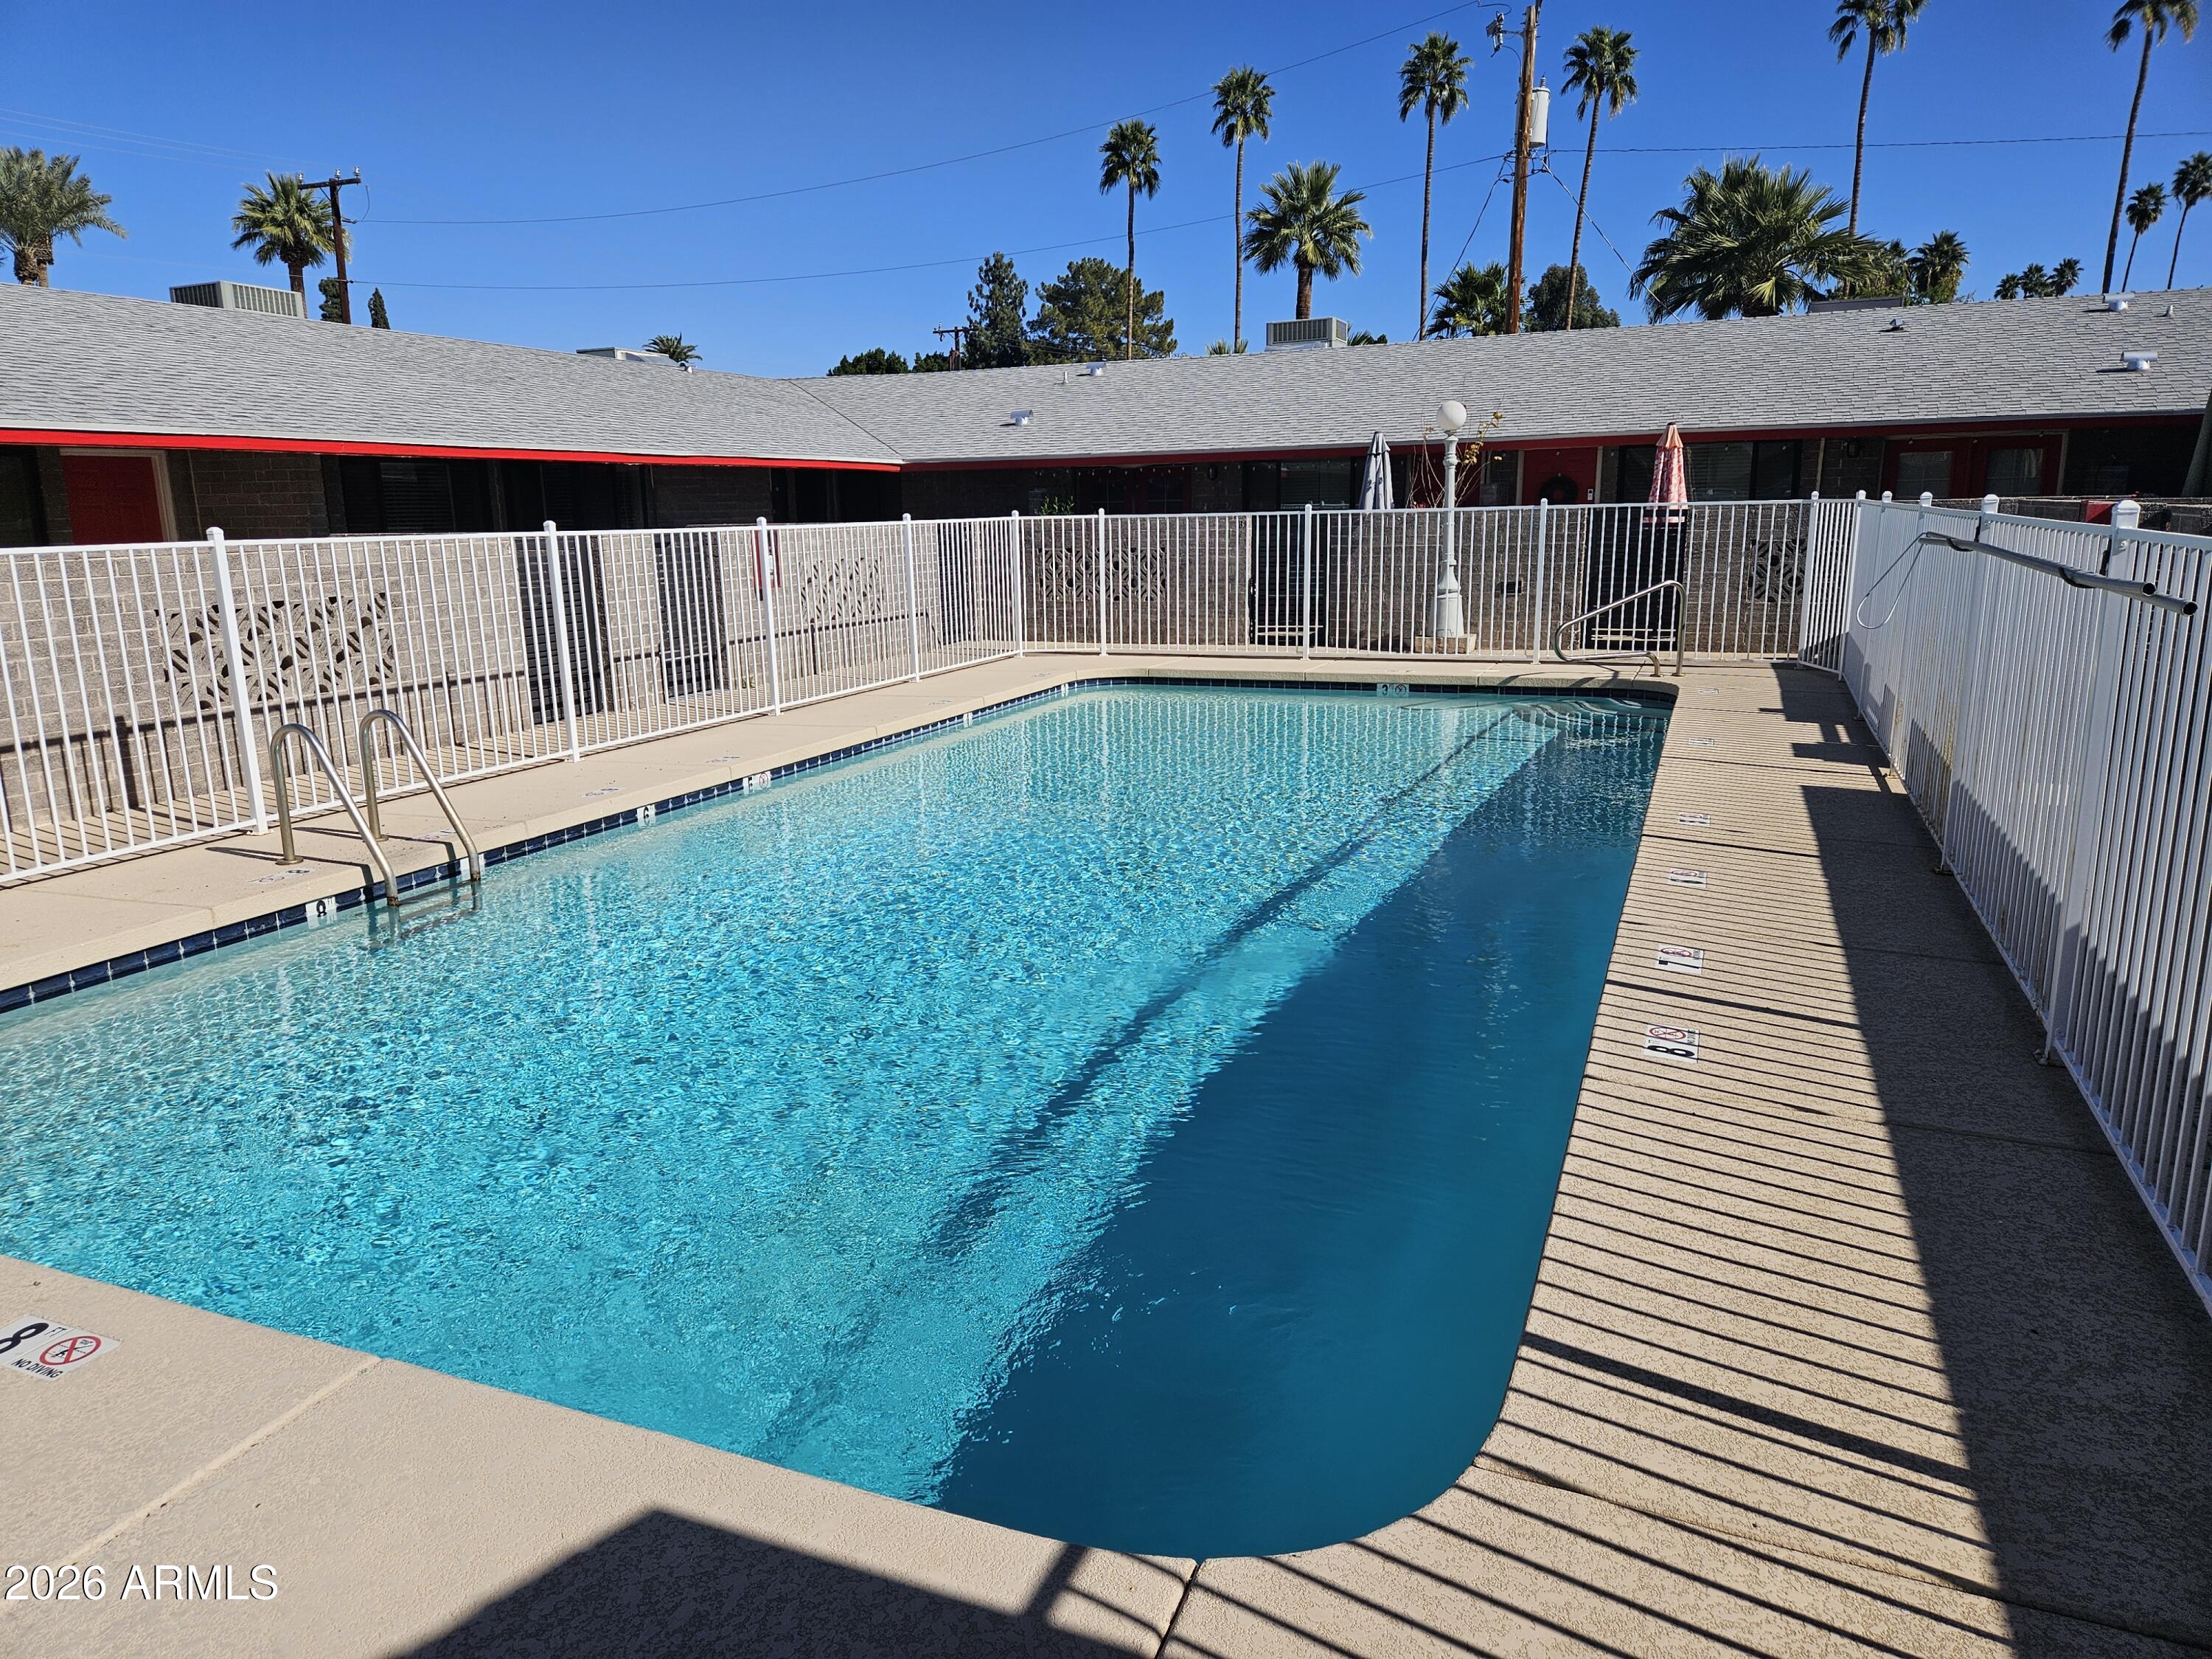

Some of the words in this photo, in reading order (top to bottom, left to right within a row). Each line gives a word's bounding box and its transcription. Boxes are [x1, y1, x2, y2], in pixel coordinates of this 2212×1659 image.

[1382, 684, 1388, 695] 3
[1647, 1045, 1695, 1057] 8
[0, 1322, 49, 1354] 8
[44, 1326, 67, 1338] FT
[10, 1358, 32, 1368] NO
[26, 1363, 63, 1378] DIVING
